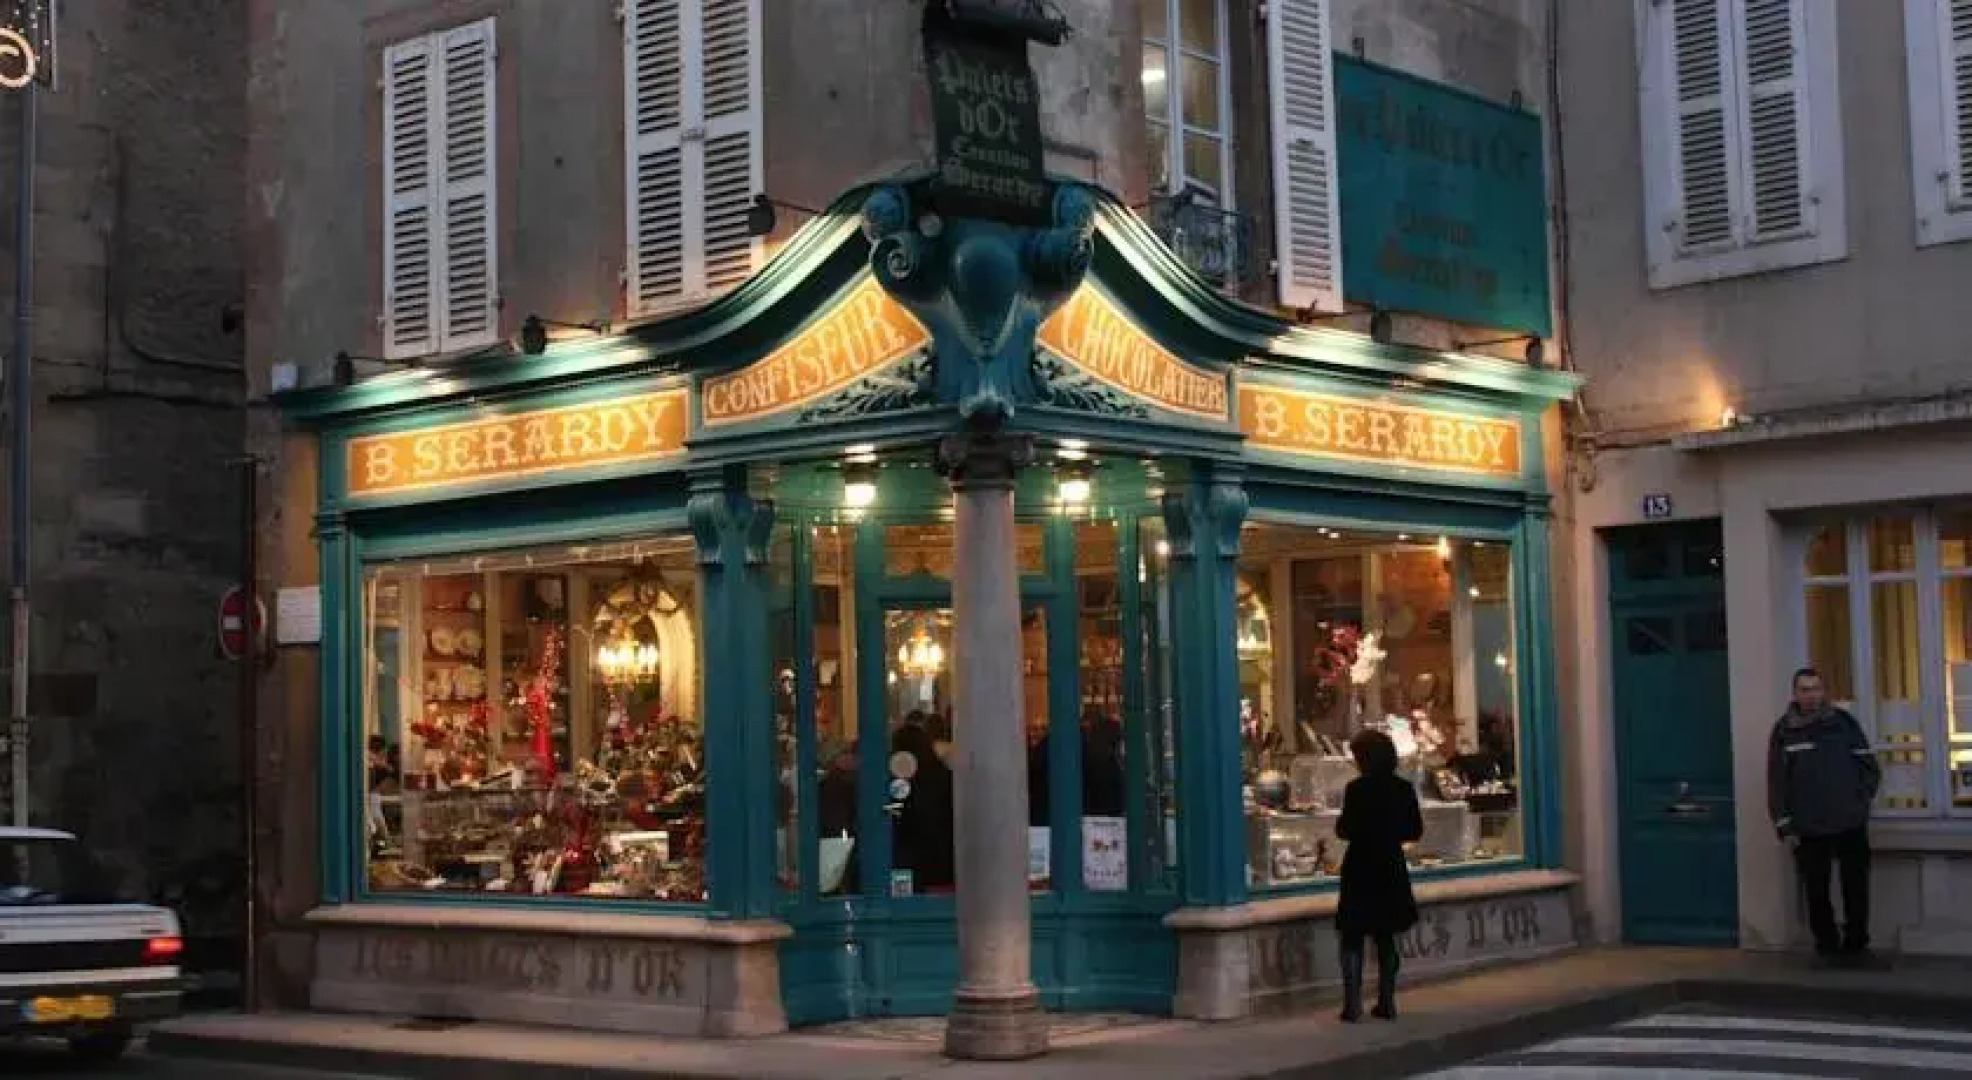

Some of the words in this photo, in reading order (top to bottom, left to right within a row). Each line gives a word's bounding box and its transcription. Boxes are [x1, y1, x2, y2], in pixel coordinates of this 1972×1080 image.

[1060, 296, 1224, 411] CHOCOLATIER
[412, 400, 672, 479] SERARDY
[1304, 404, 1509, 466] SERARDY
[1467, 901, 1541, 950] D'OR
[585, 943, 686, 997] D'OR
